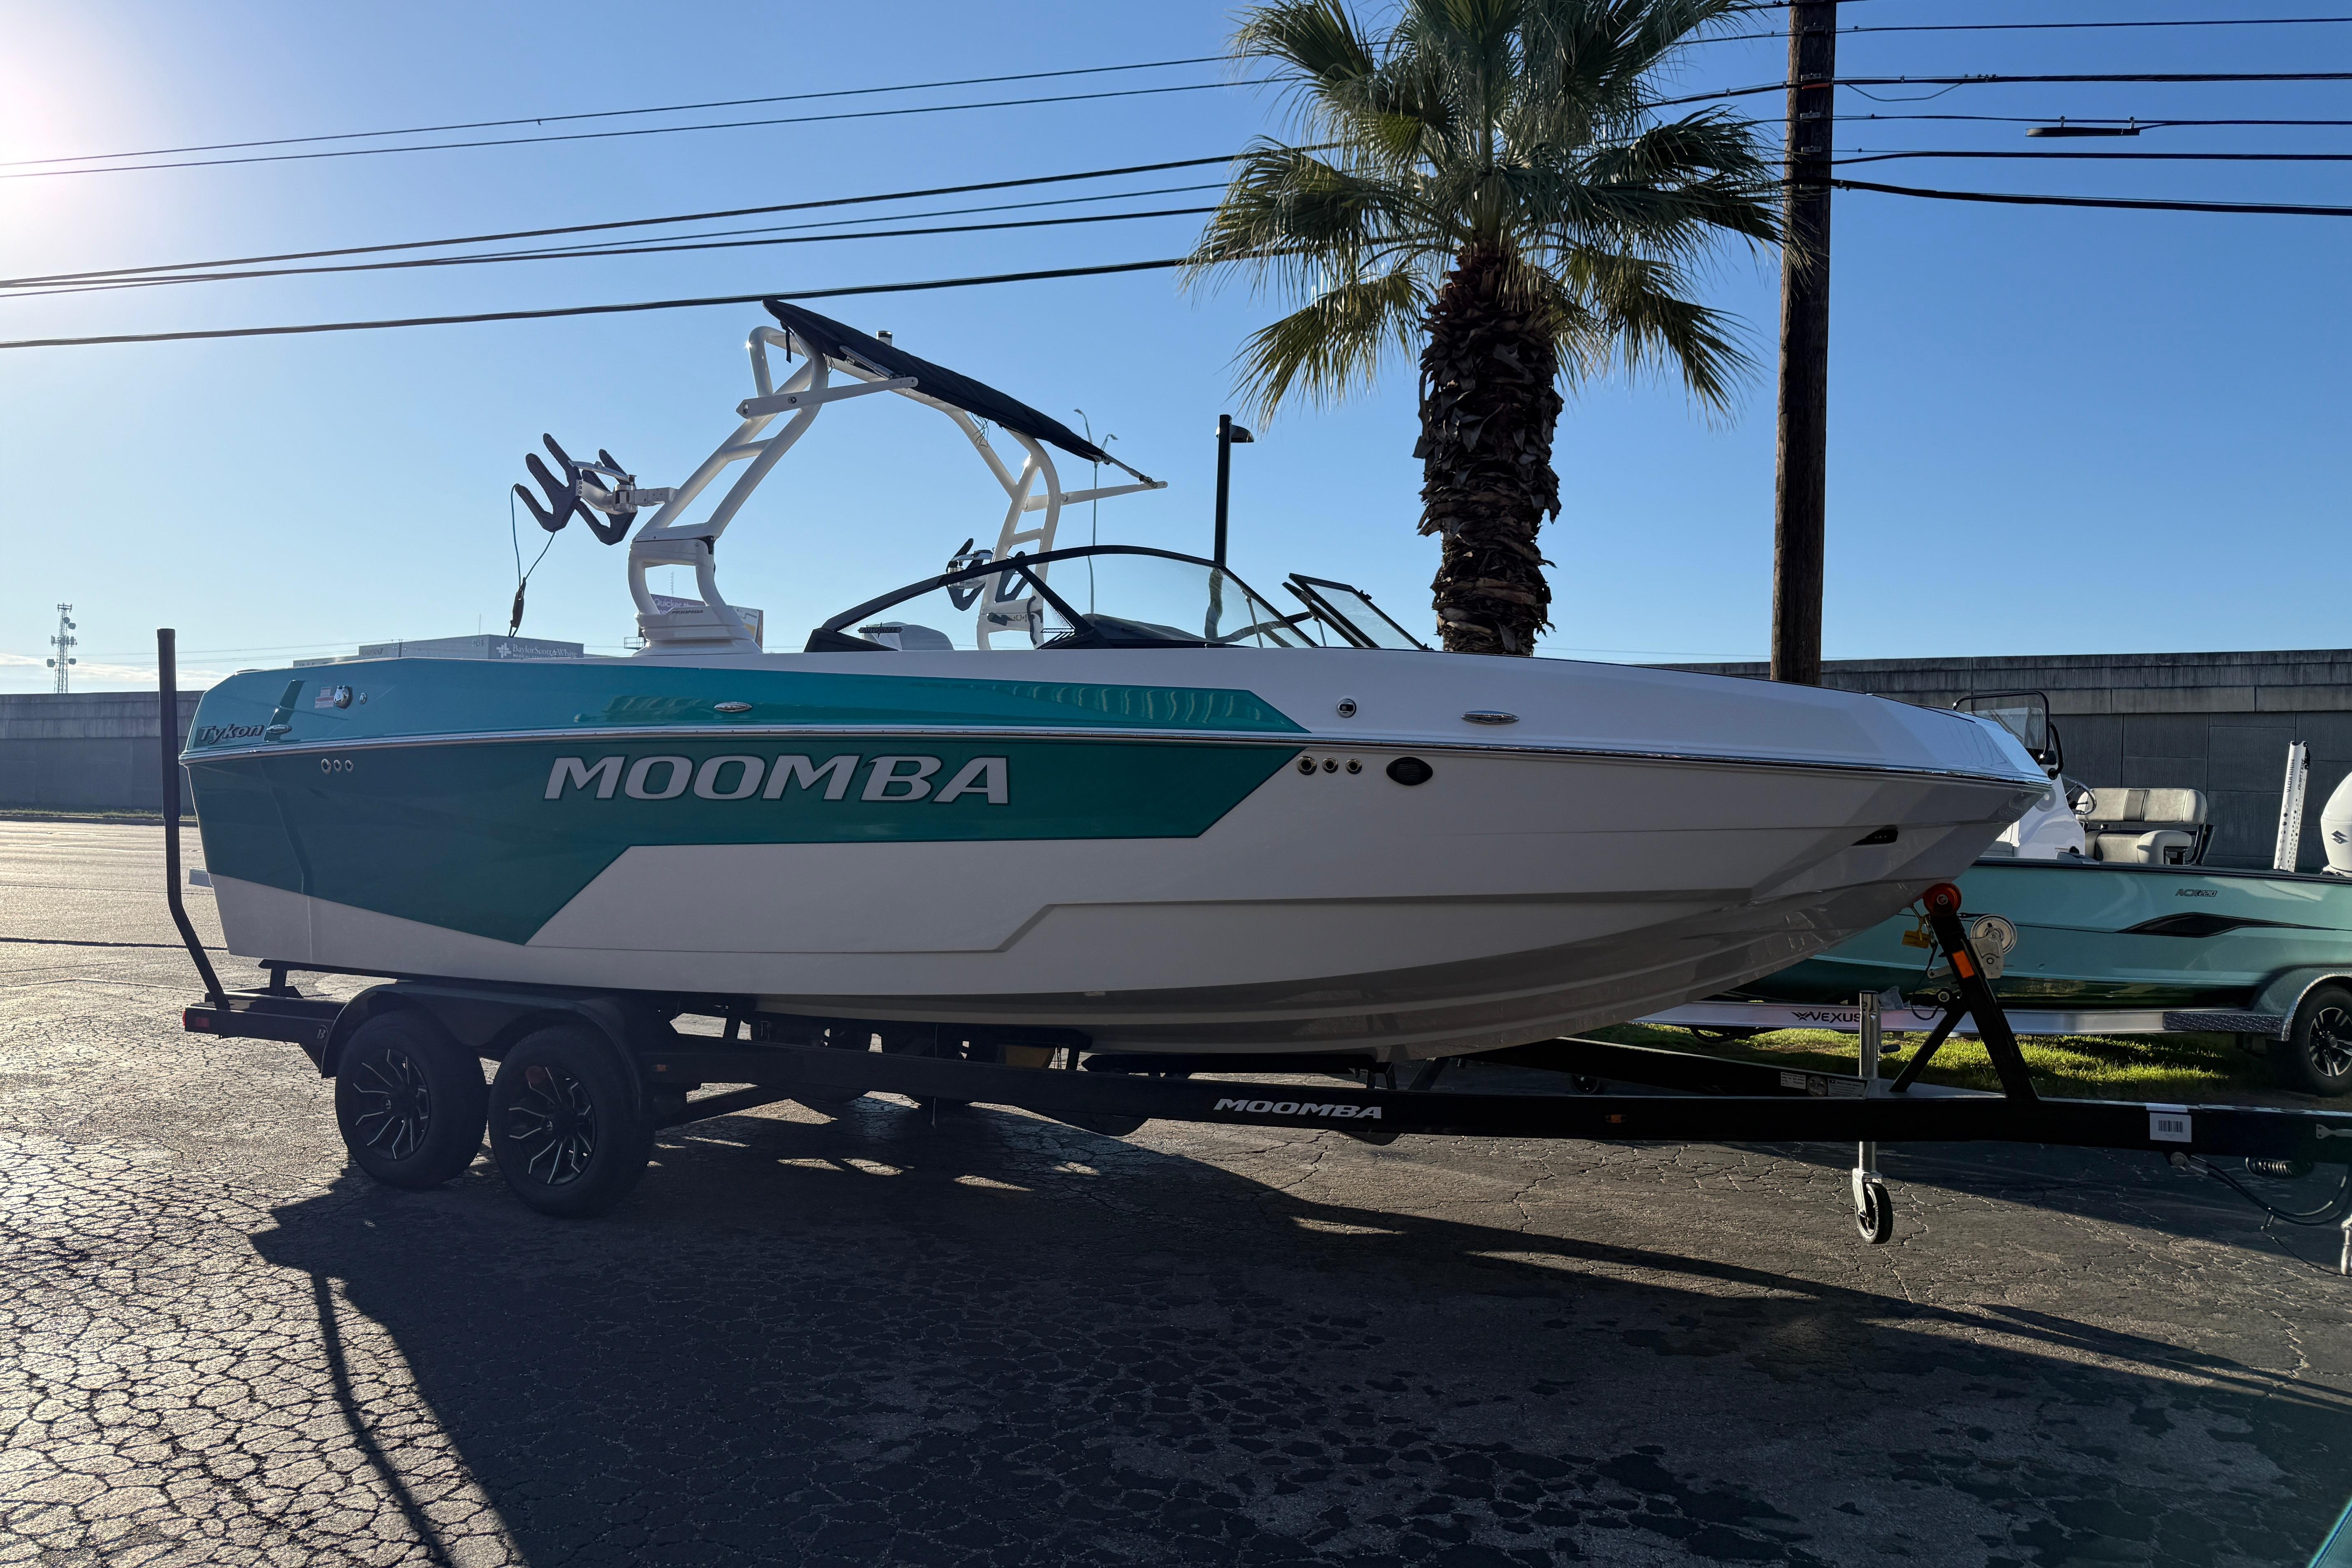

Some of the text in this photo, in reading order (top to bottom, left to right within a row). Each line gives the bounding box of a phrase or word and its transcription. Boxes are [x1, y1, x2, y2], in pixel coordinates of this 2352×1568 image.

[654, 598, 682, 607] Quicker
[200, 723, 265, 744] Tykon
[544, 754, 1010, 805] MOOMBA
[1213, 1098, 1382, 1119] MOOMBA
